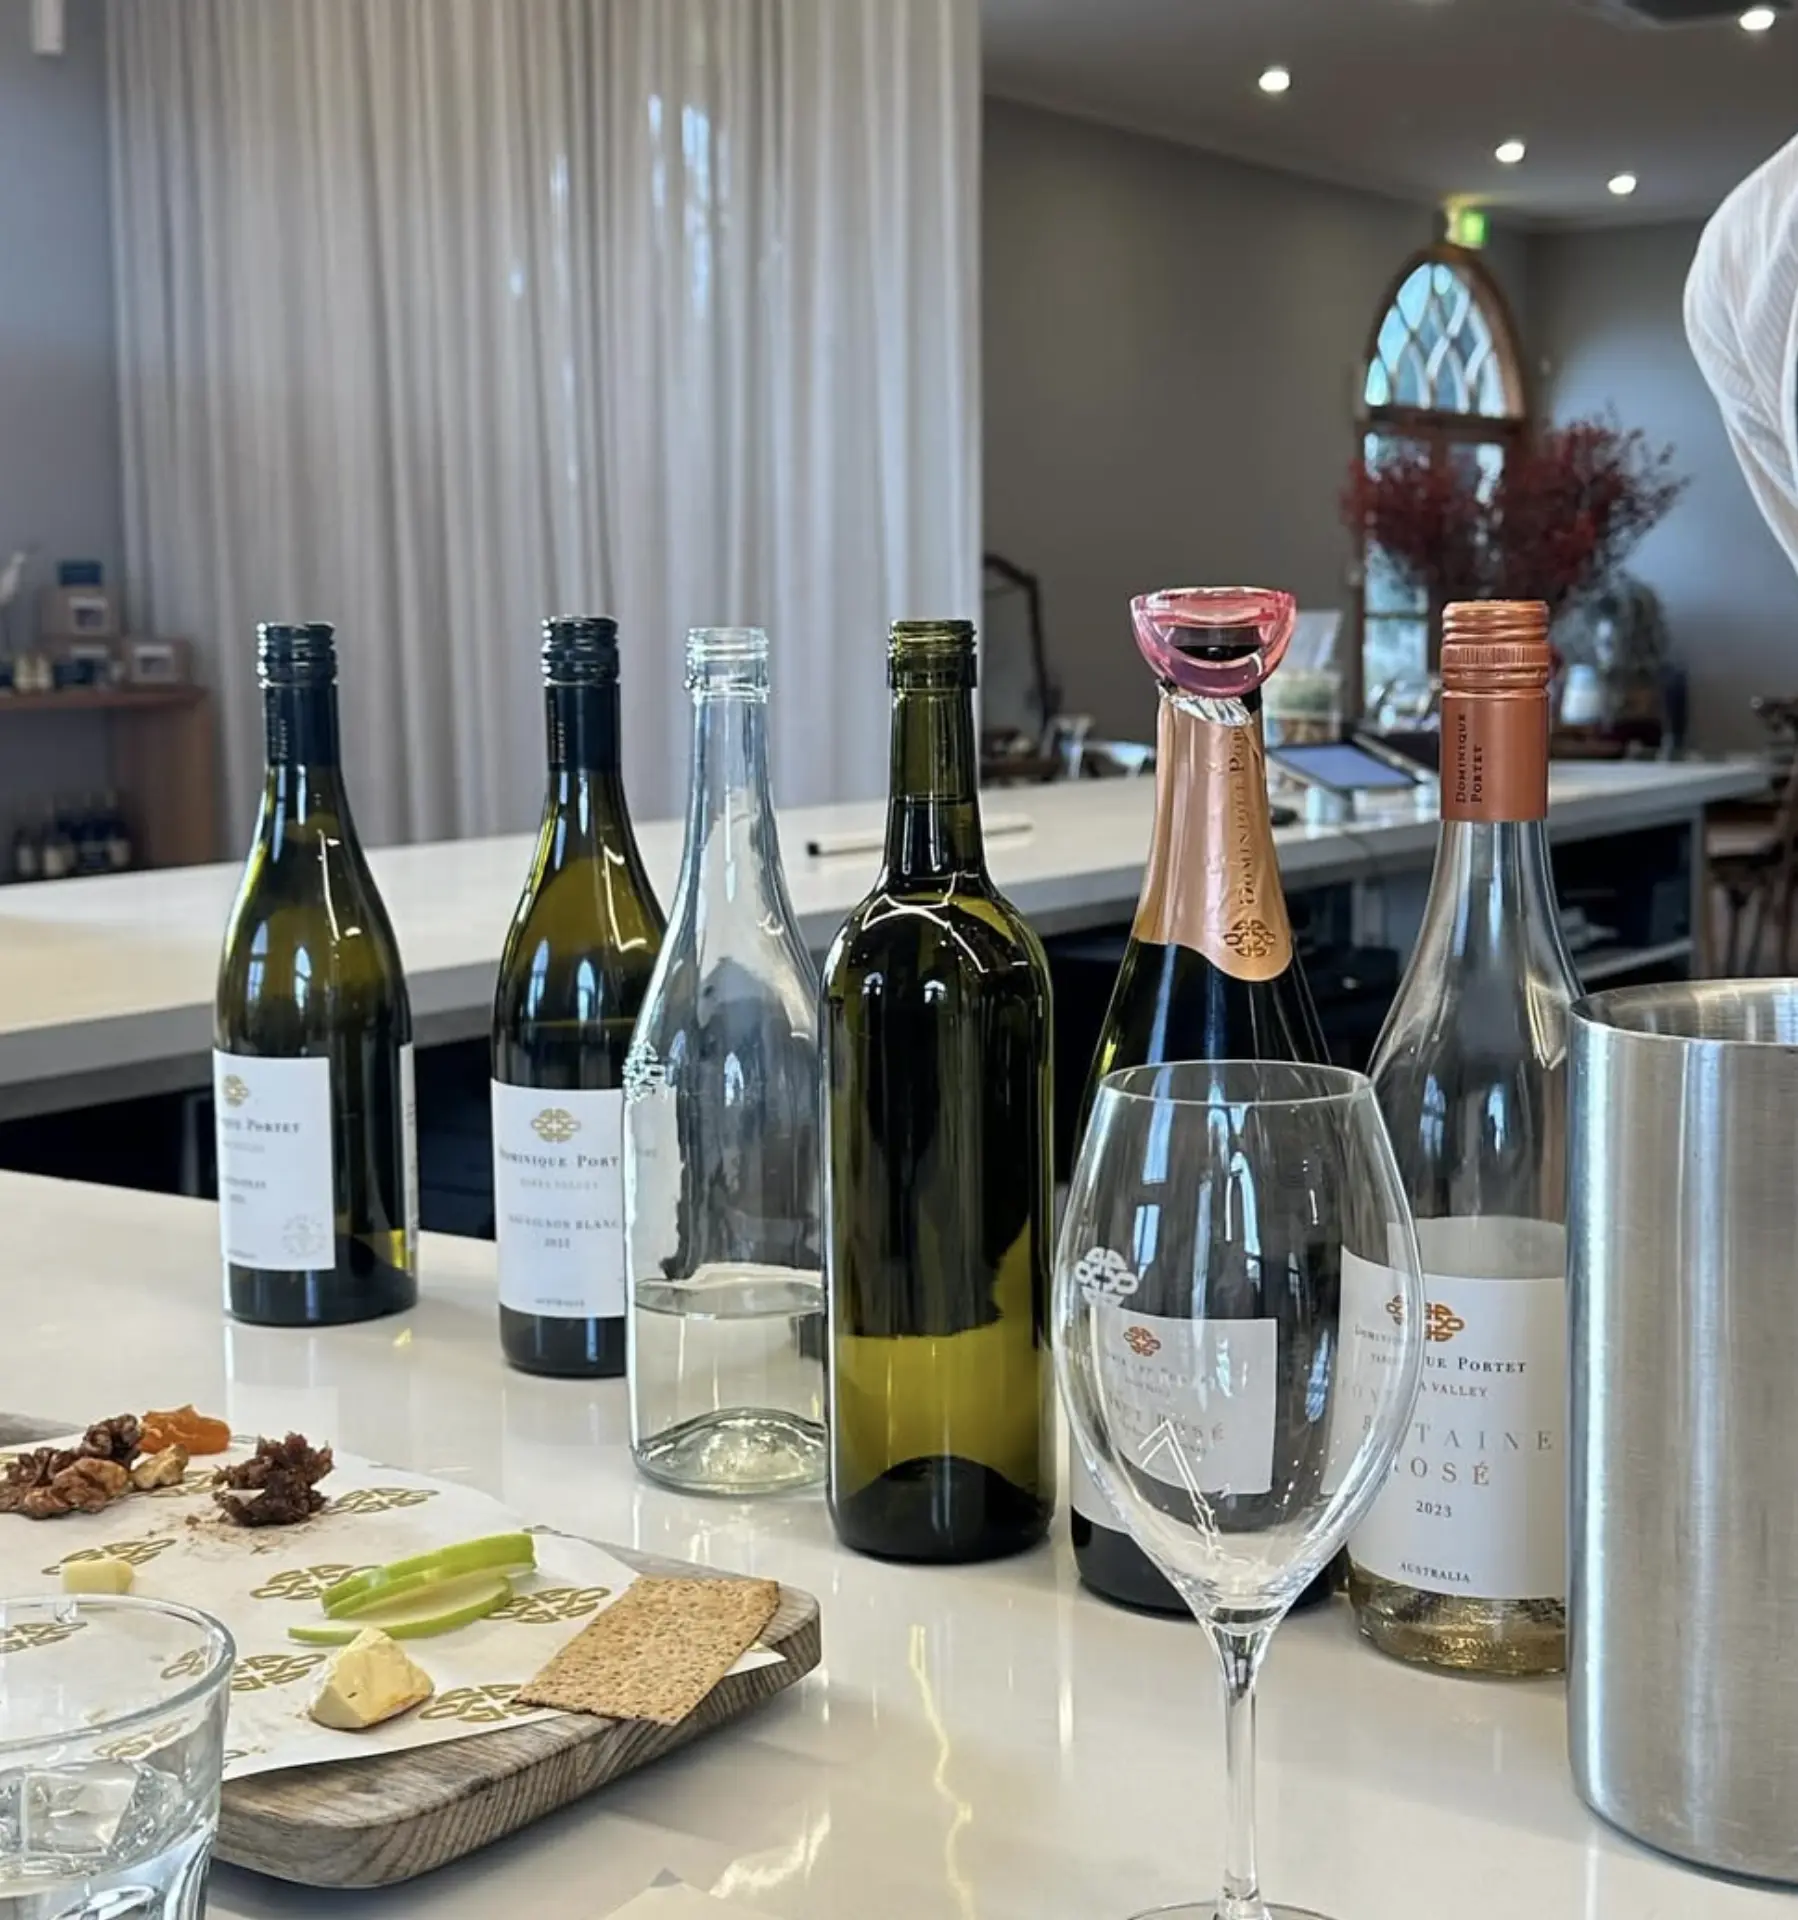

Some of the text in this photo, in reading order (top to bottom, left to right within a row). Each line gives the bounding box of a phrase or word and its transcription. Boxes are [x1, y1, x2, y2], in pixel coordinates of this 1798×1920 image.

[1228, 727, 1245, 773] POR
[1455, 713, 1467, 803] DOMINIQUE
[1470, 745, 1482, 803] PORTET
[499, 1147, 619, 1169] MINIQUE PORT
[1457, 1356, 1527, 1374] PORTET
[1431, 1381, 1488, 1398] VALLEY
[1414, 1421, 1553, 1450] TAINE
[1395, 1455, 1490, 1486] OSÉ
[1415, 1500, 1453, 1518] 2023
[1399, 1562, 1471, 1583] AUSTRALIA
